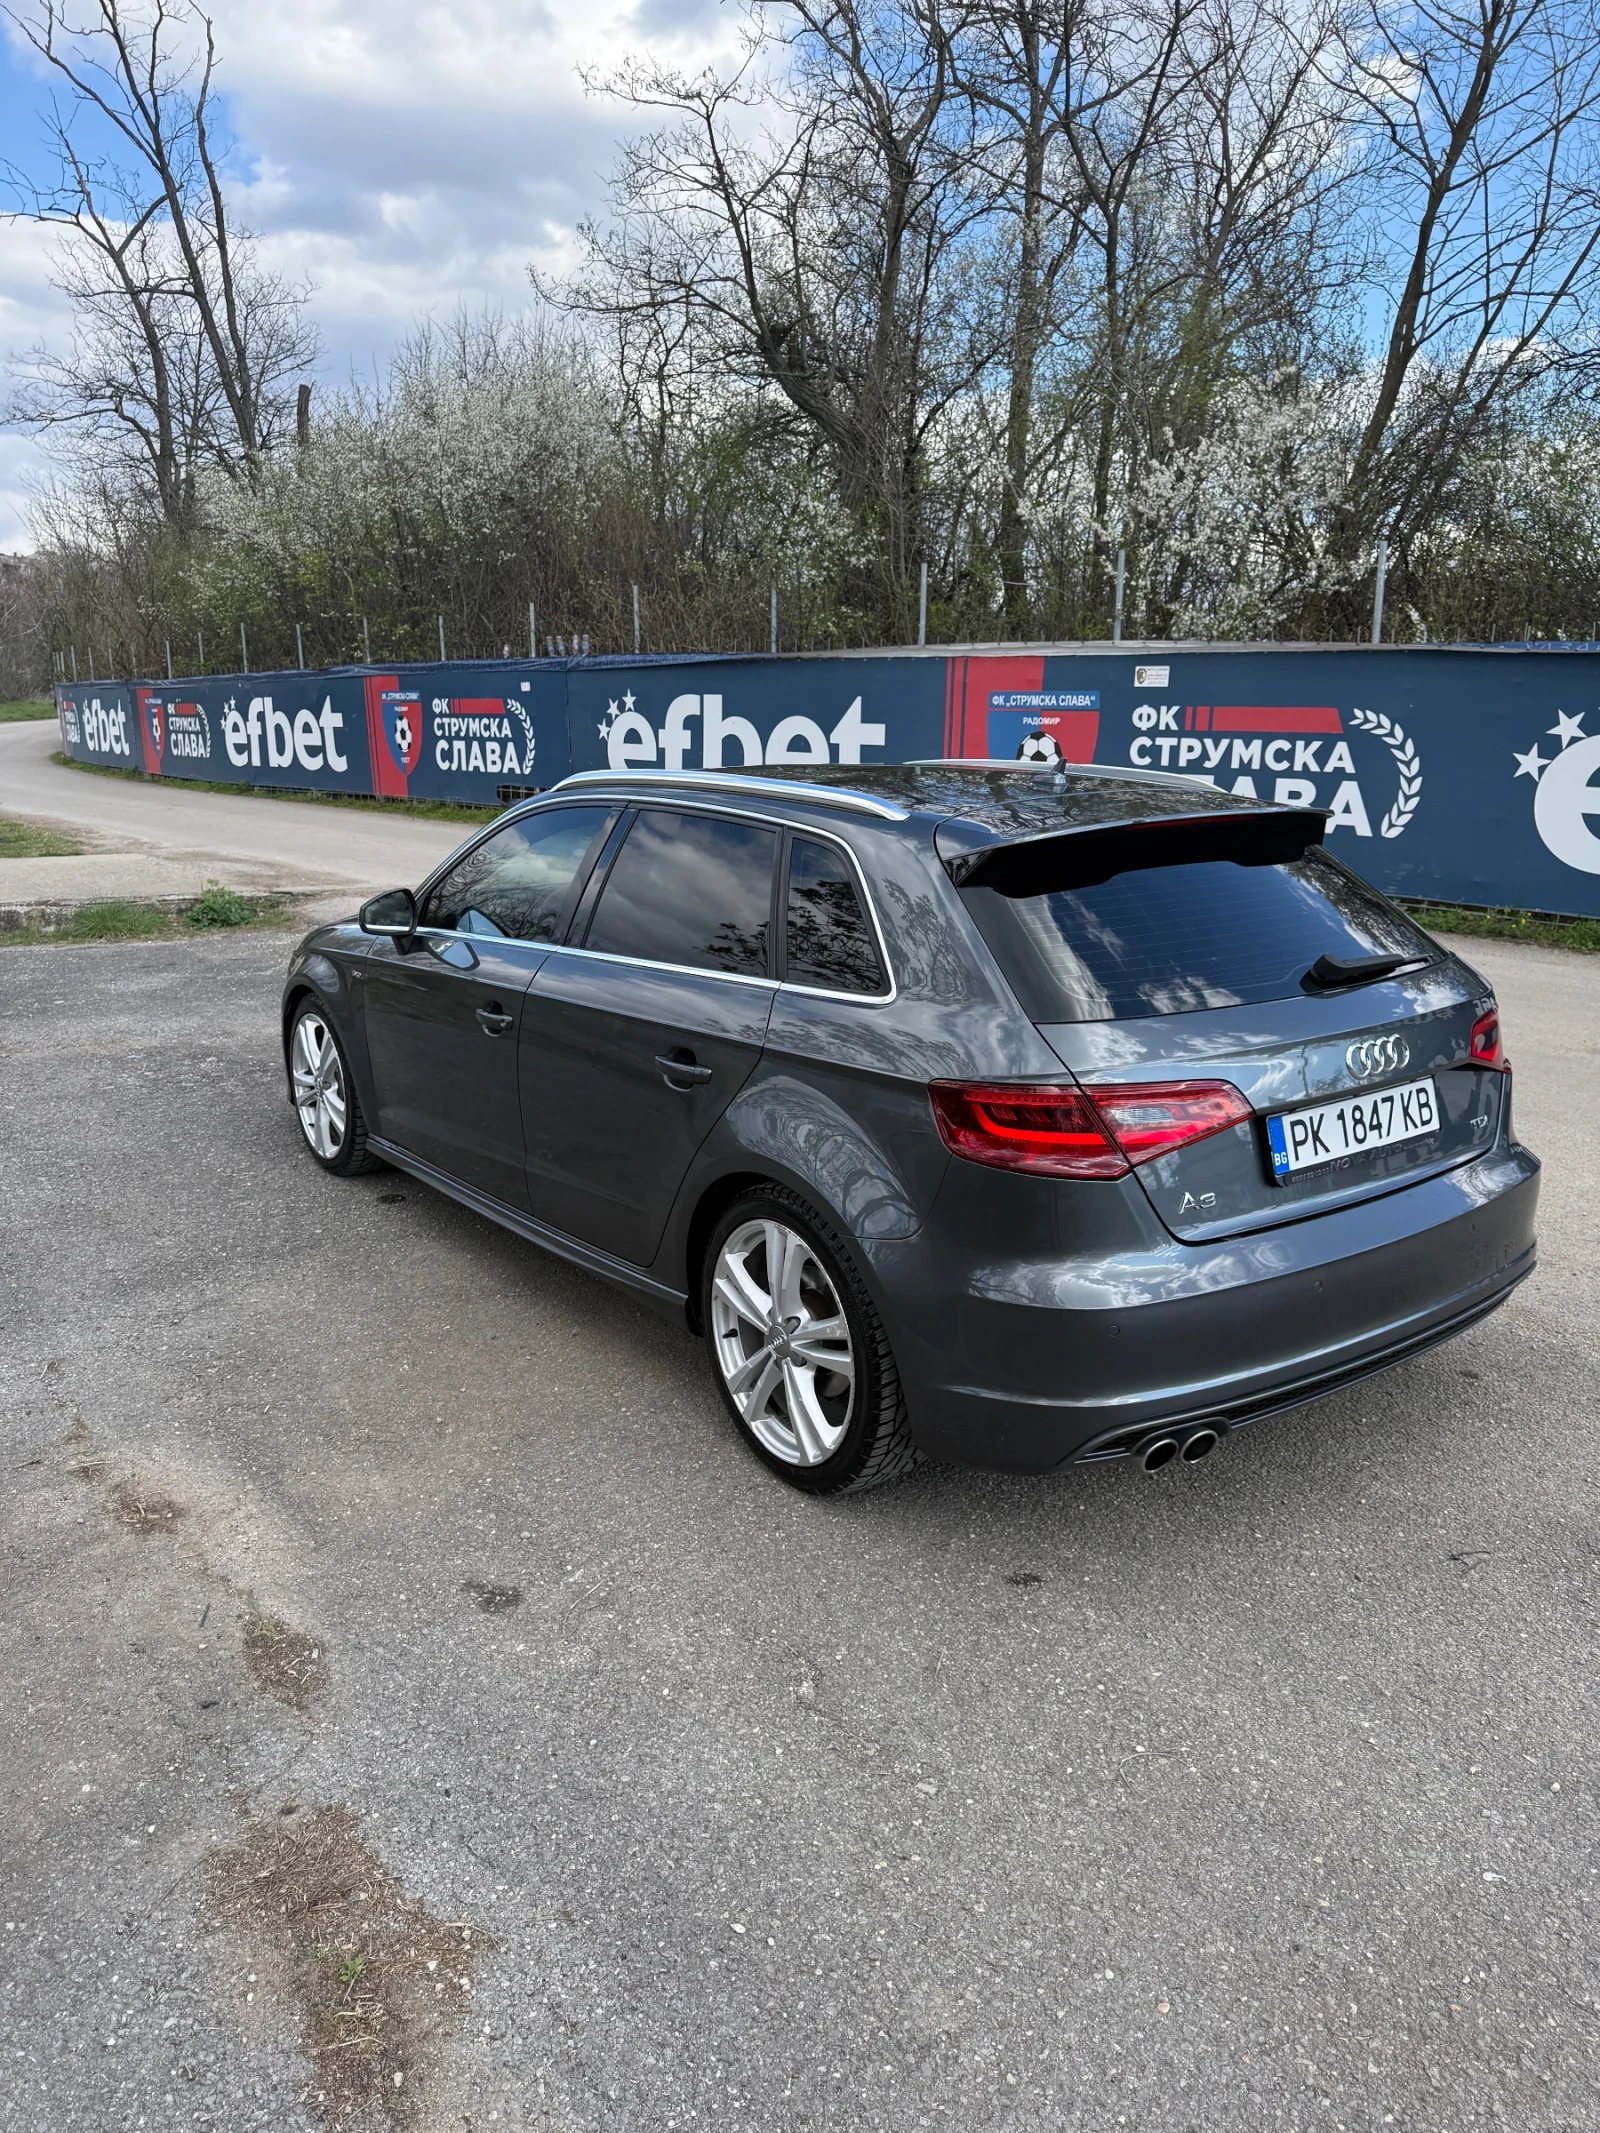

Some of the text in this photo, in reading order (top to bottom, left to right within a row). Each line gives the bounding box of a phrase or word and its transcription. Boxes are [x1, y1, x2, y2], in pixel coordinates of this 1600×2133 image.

[432, 698, 450, 715] ФК
[992, 695, 1005, 705] ФК
[84, 698, 130, 756] efbet
[169, 716, 201, 732] СТРУМСКА
[433, 717, 513, 739] СТРУМСКА
[1023, 716, 1061, 726] РАДОМИР
[1132, 704, 1179, 731] ФК
[171, 732, 206, 758] СЛАВА
[225, 695, 348, 772] efbet
[435, 739, 522, 775] СЛАВА
[1129, 736, 1357, 774] СТРУМСКА
[1336, 1095, 1395, 1149] 1847
[1273, 1151, 1288, 1166] BG
[1178, 1191, 1217, 1215] A3
